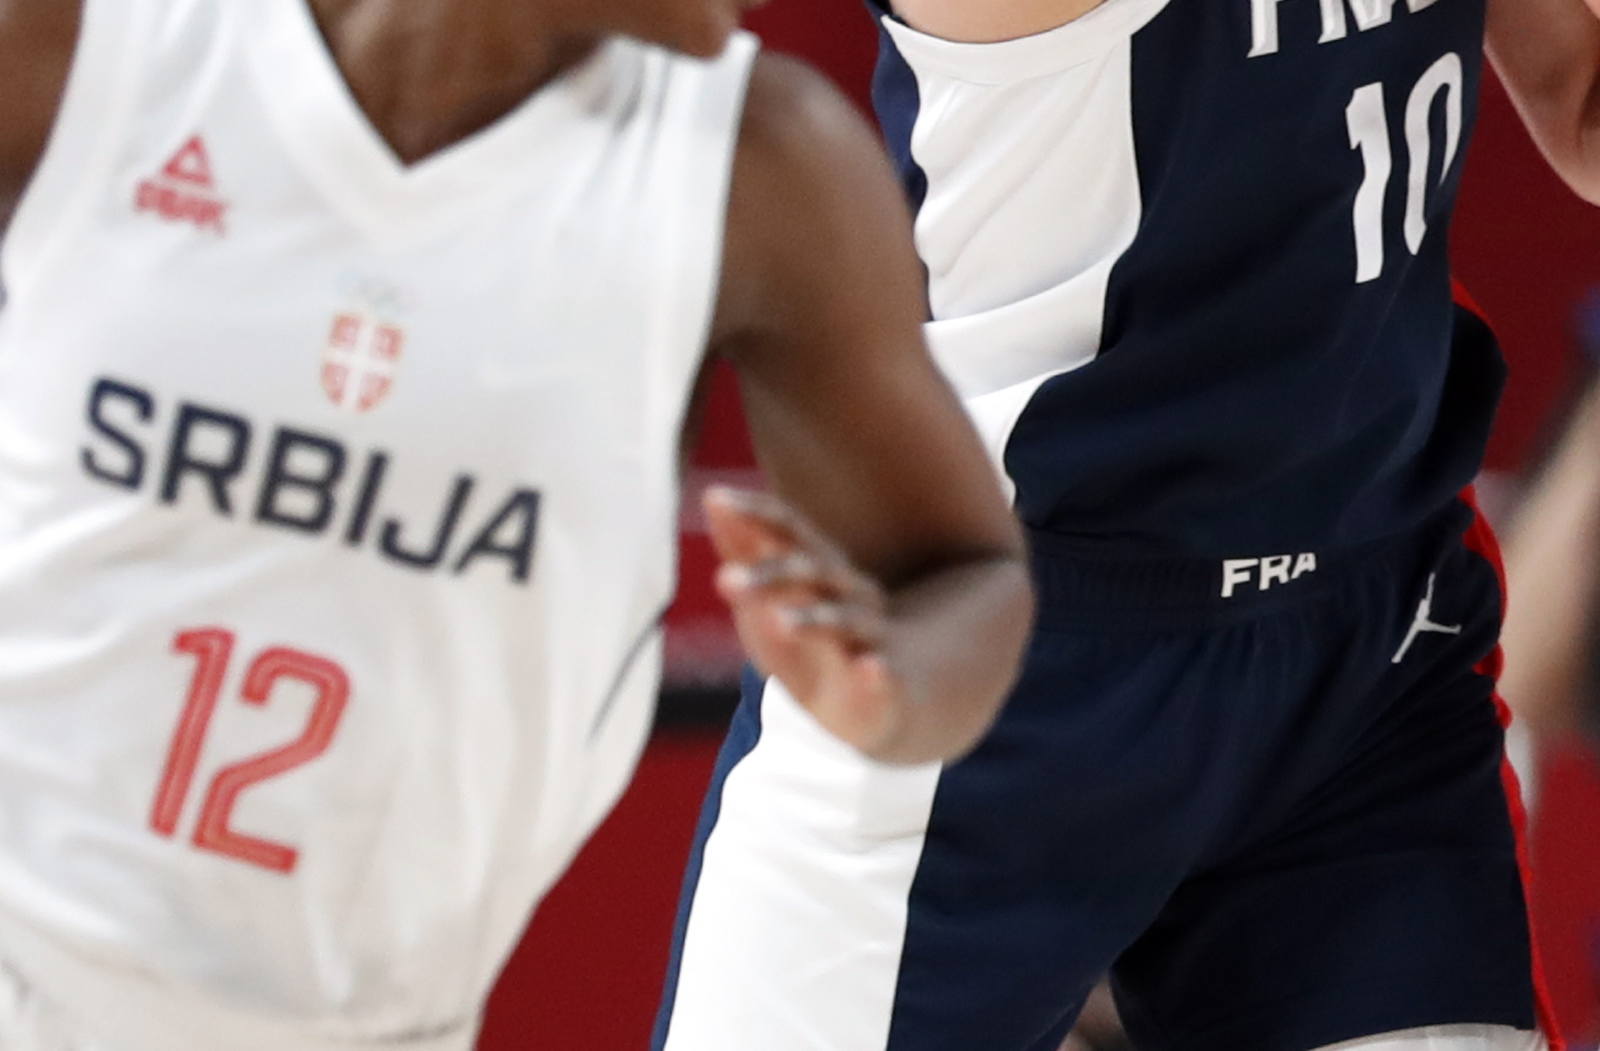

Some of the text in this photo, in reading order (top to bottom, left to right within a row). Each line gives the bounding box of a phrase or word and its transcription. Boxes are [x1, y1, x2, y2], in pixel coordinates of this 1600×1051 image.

[1345, 51, 1463, 284] 10
[79, 376, 543, 586] SRBIJA
[1221, 552, 1316, 598] FRA
[147, 625, 351, 876] 12
